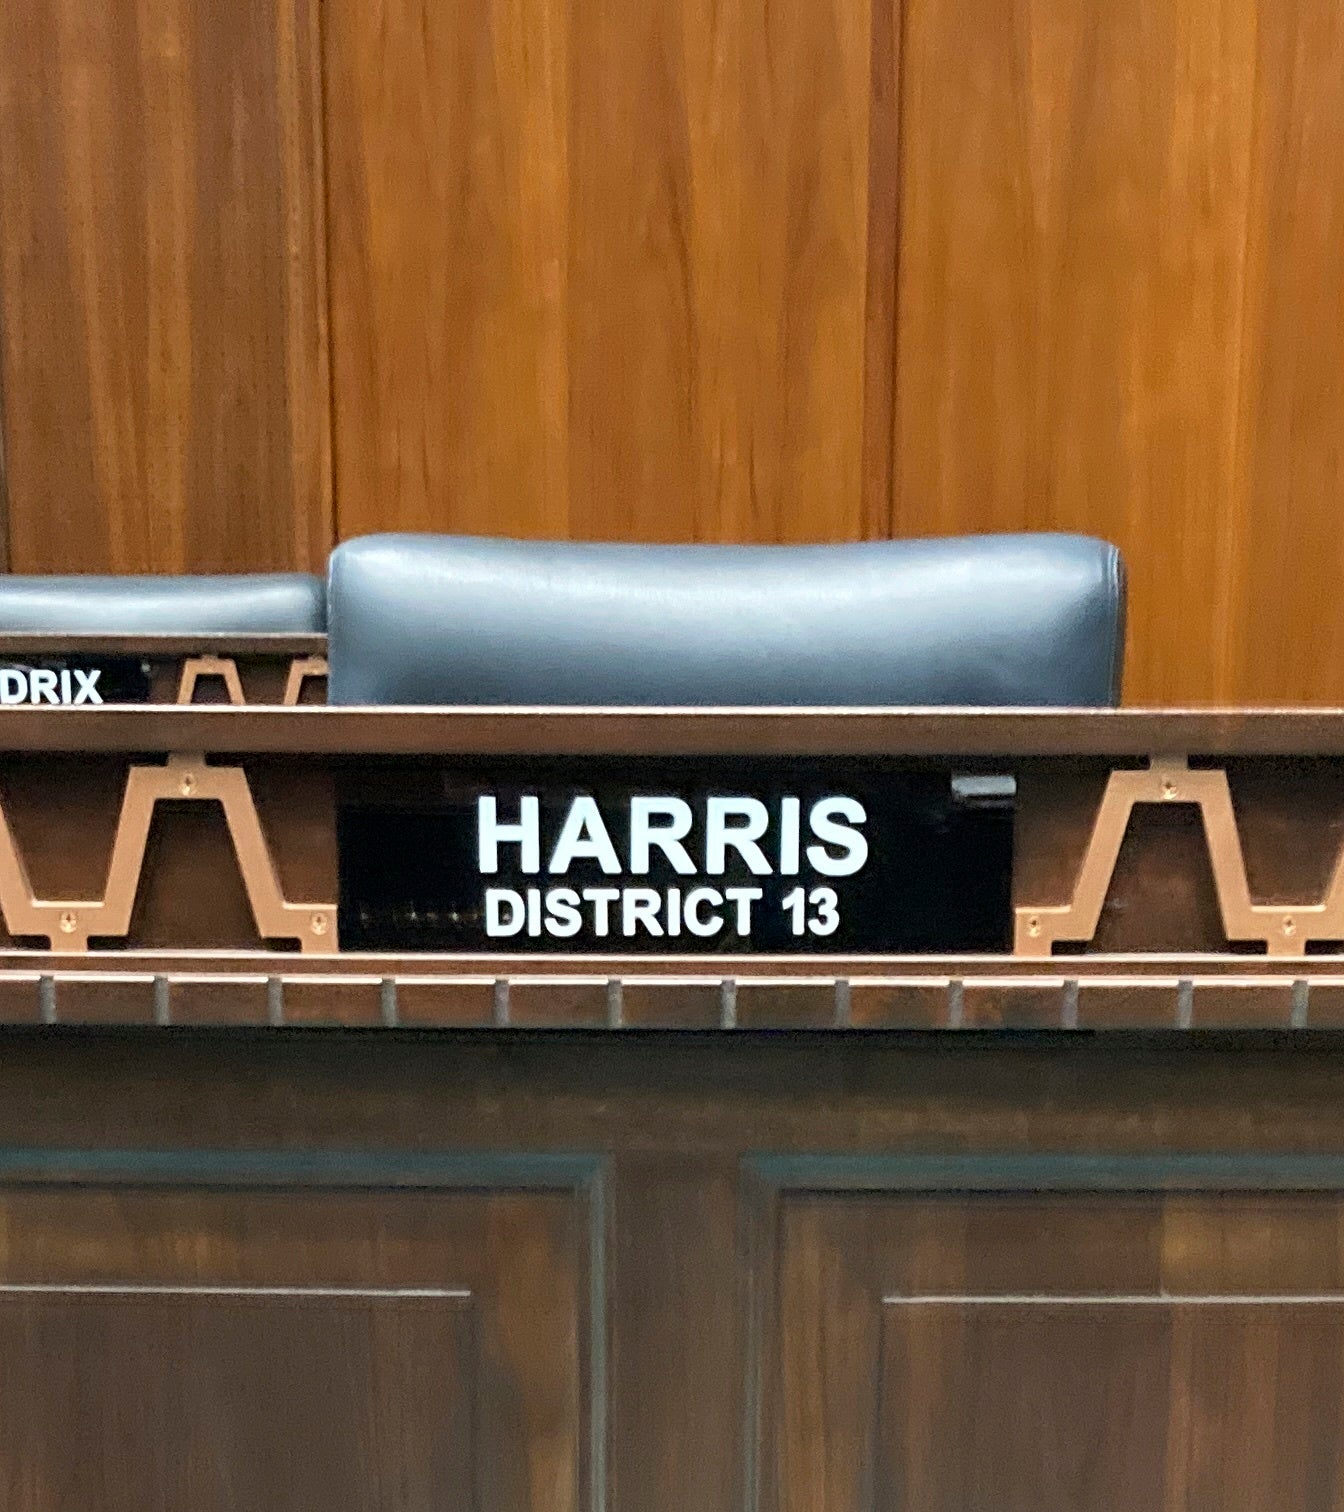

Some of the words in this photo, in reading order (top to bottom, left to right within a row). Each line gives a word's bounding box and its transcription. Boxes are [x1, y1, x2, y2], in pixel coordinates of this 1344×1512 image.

[477, 795, 869, 877] HARRIS
[485, 887, 763, 937] DISTRICT
[781, 886, 841, 936] 13
